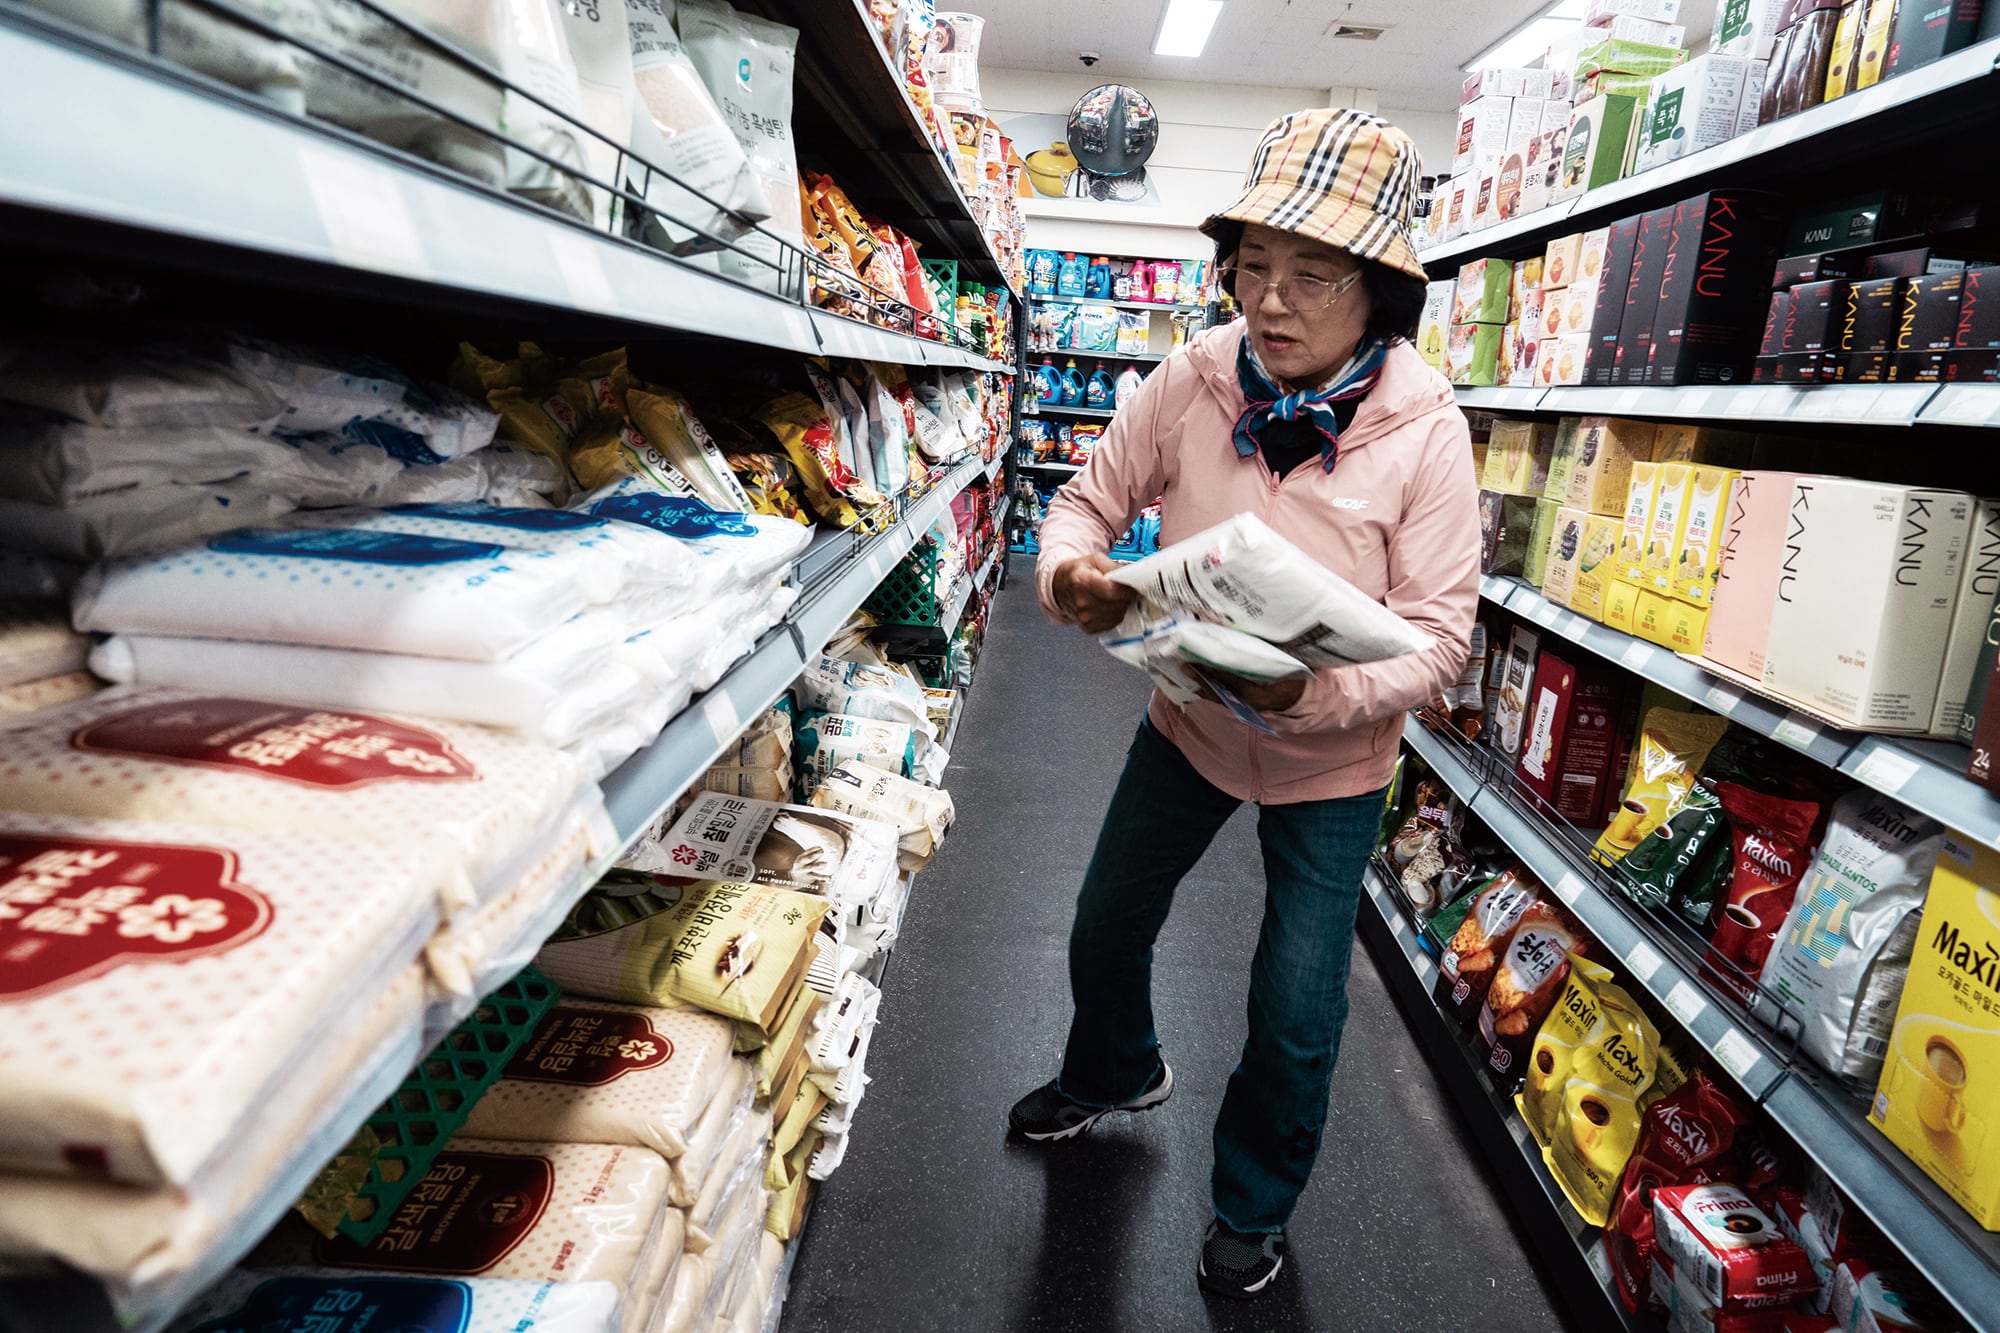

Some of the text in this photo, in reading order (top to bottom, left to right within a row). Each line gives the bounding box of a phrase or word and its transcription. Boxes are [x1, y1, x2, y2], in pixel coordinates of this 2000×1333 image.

[1660, 205, 1687, 299] KANU
[1696, 198, 1739, 296] KANU
[1805, 227, 1832, 243] KANU
[1597, 226, 1617, 308] KANU
[1626, 216, 1652, 304] KANU
[1761, 295, 1781, 353] KANU
[1782, 287, 1800, 349] KANU
[1842, 285, 1861, 350] KANU
[1897, 280, 1923, 349] KANU
[1956, 273, 1982, 346] KANU
[1720, 477, 1755, 580] KANU
[1778, 485, 1813, 603] KANU
[1896, 499, 1933, 585] KANU
[824, 716, 844, 737] 곰표
[1962, 714, 1975, 731] 30
[1972, 748, 1991, 770] 24
[1858, 804, 1919, 843] Maxim
[695, 850, 719, 873] 백설
[1741, 835, 1792, 876] Maxim
[1841, 866, 1878, 893] SANTOS
[783, 907, 803, 926] 3kg
[670, 924, 709, 966] 깨끗한
[1453, 979, 1470, 999] 50
[1937, 966, 2000, 1018] 모카골드 마일드
[538, 1016, 605, 1074] 갈색설탕
[1492, 1043, 1512, 1068] 50
[1614, 1069, 1635, 1086] Gold
[376, 1163, 467, 1254] 갈색설탕
[430, 1198, 463, 1243] BROWN
[1697, 1197, 1754, 1214] Frima
